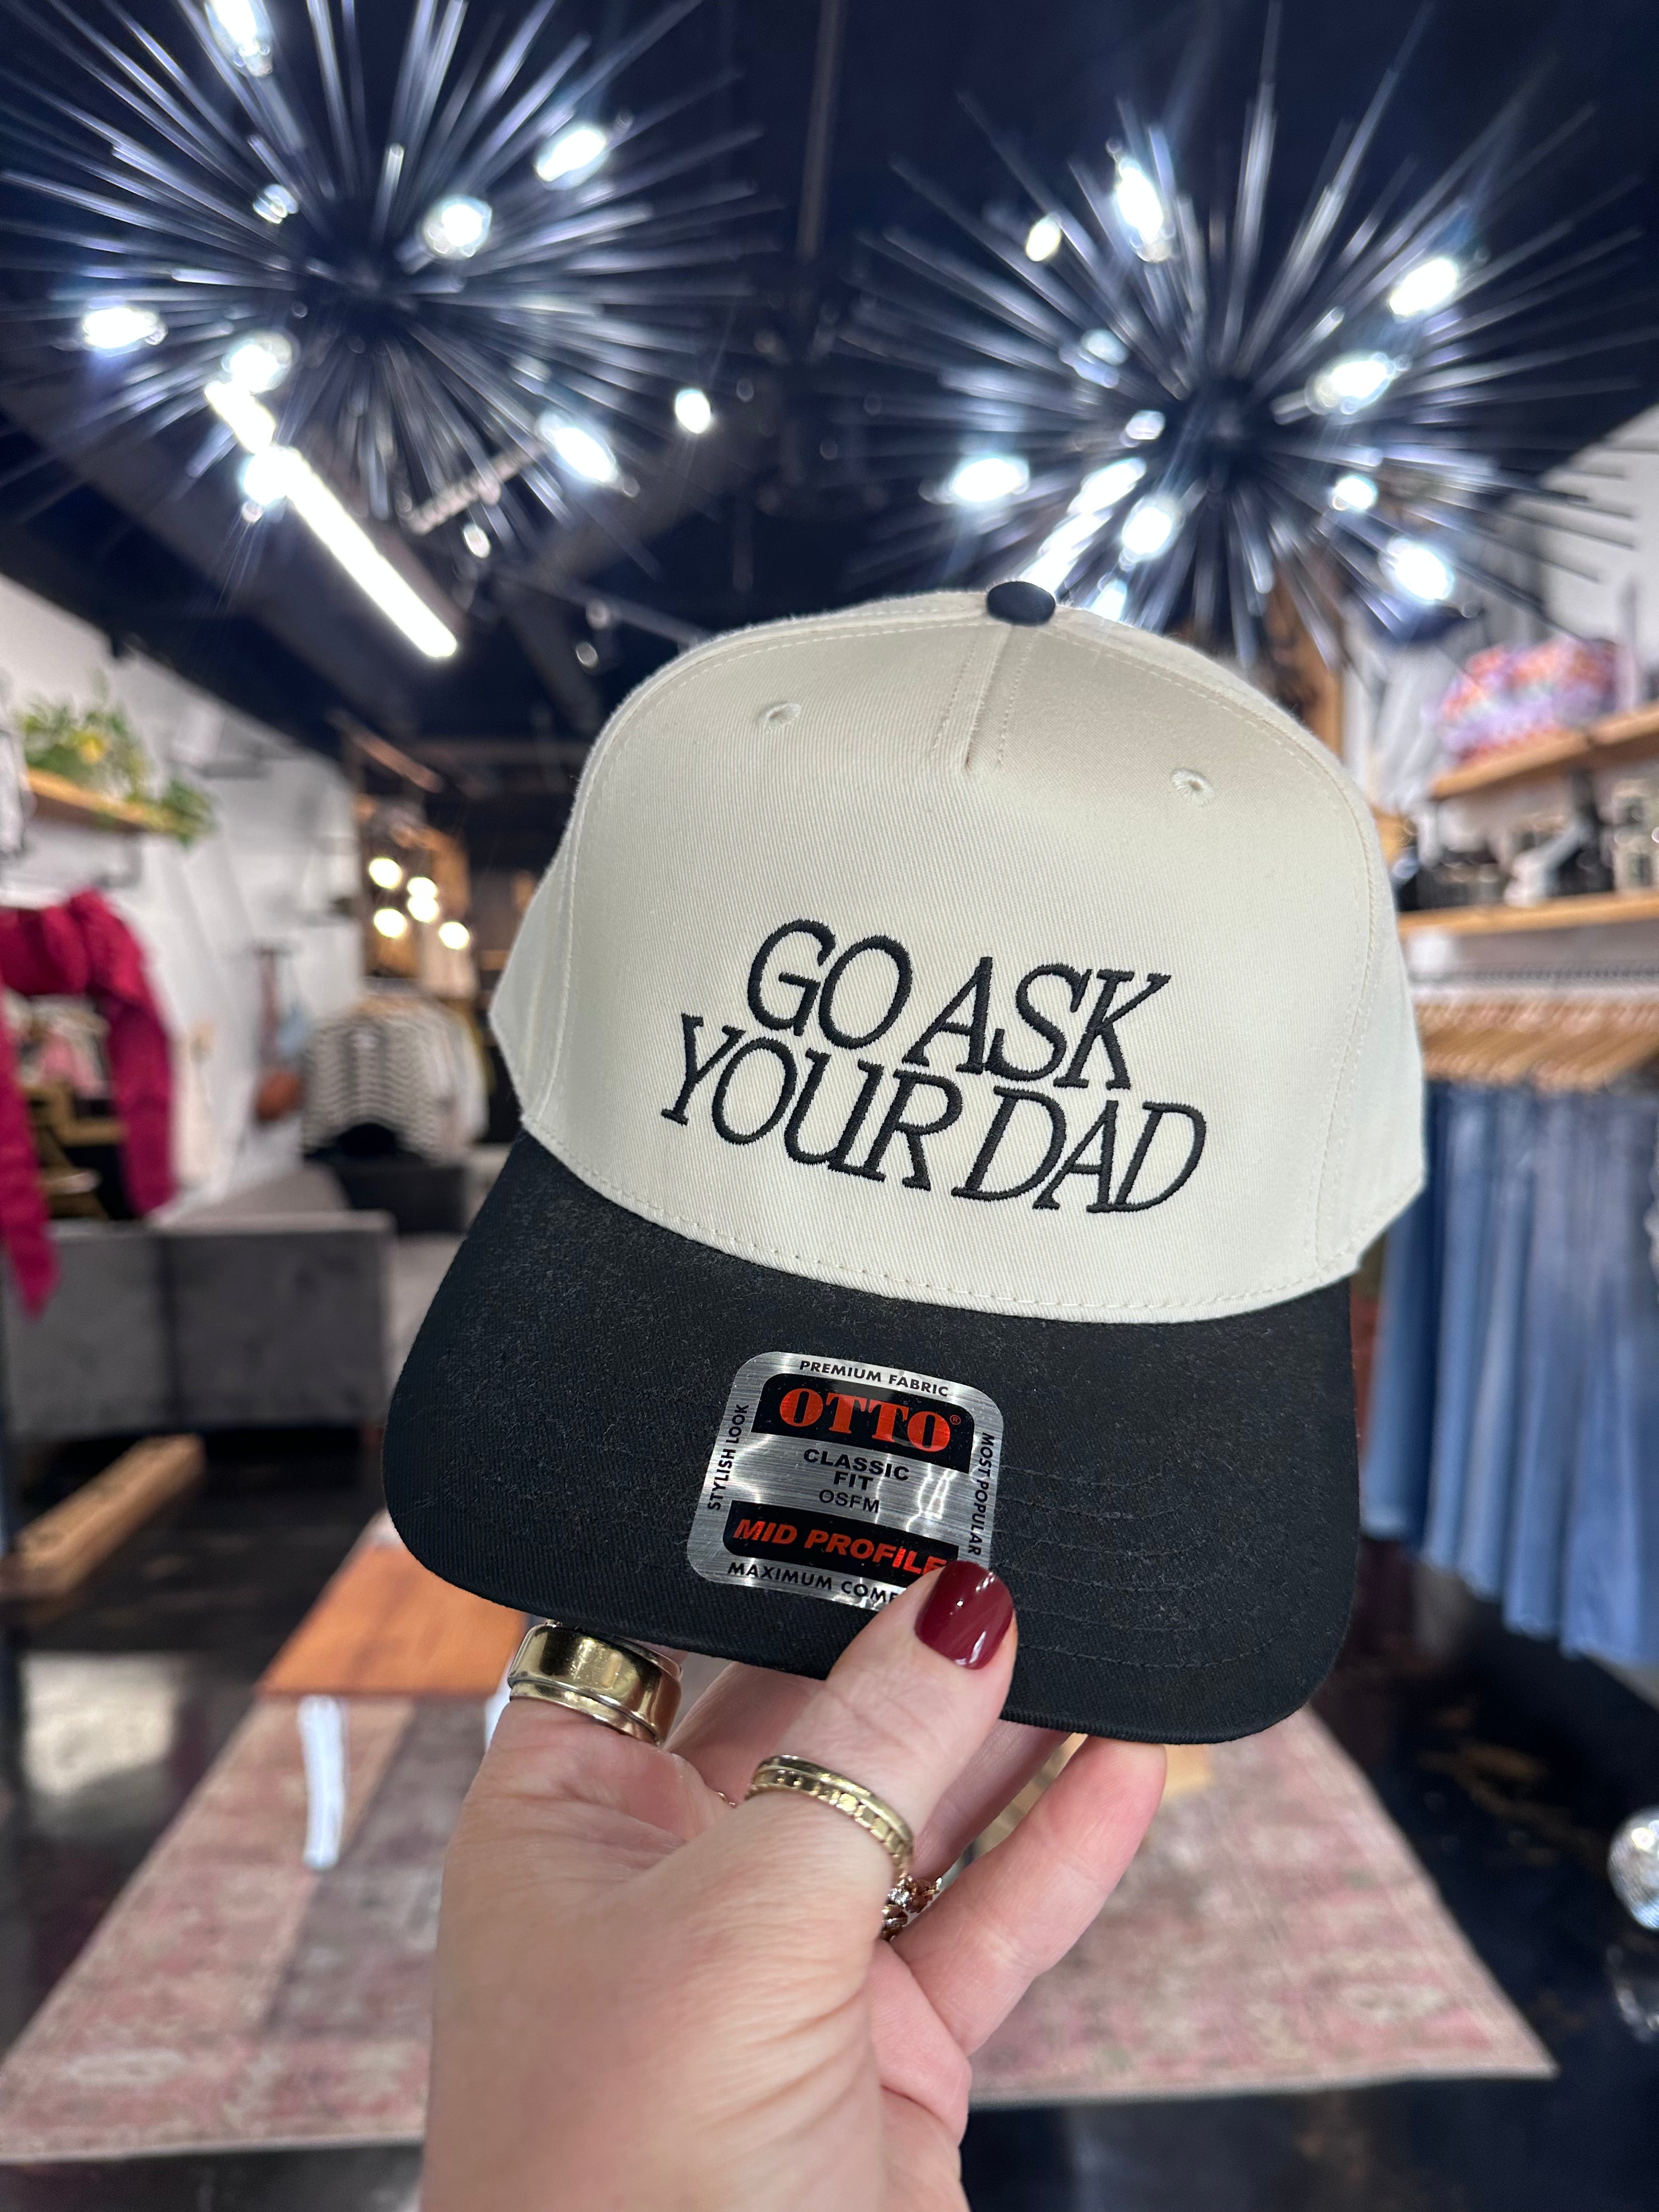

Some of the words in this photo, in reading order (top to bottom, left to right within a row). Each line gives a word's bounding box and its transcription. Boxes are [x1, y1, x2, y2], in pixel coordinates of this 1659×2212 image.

[748, 919, 912, 1049] GO
[902, 956, 1171, 1090] ASK
[661, 1013, 962, 1191] YOUR
[951, 1085, 1206, 1214] DAD
[799, 1360, 881, 1383] PREMIUM
[889, 1375, 949, 1397] FABRIC
[708, 1450, 736, 1510] STYLISH
[728, 1404, 749, 1444] LOOK
[804, 1449, 910, 1481] CLASSIC
[978, 1432, 995, 1477] MOST
[833, 1471, 874, 1491] FIT
[819, 1489, 879, 1513] OSFM
[968, 1479, 989, 1556] POPULAR
[733, 1519, 797, 1545] MID
[727, 1562, 833, 1590] MAXIMUM
